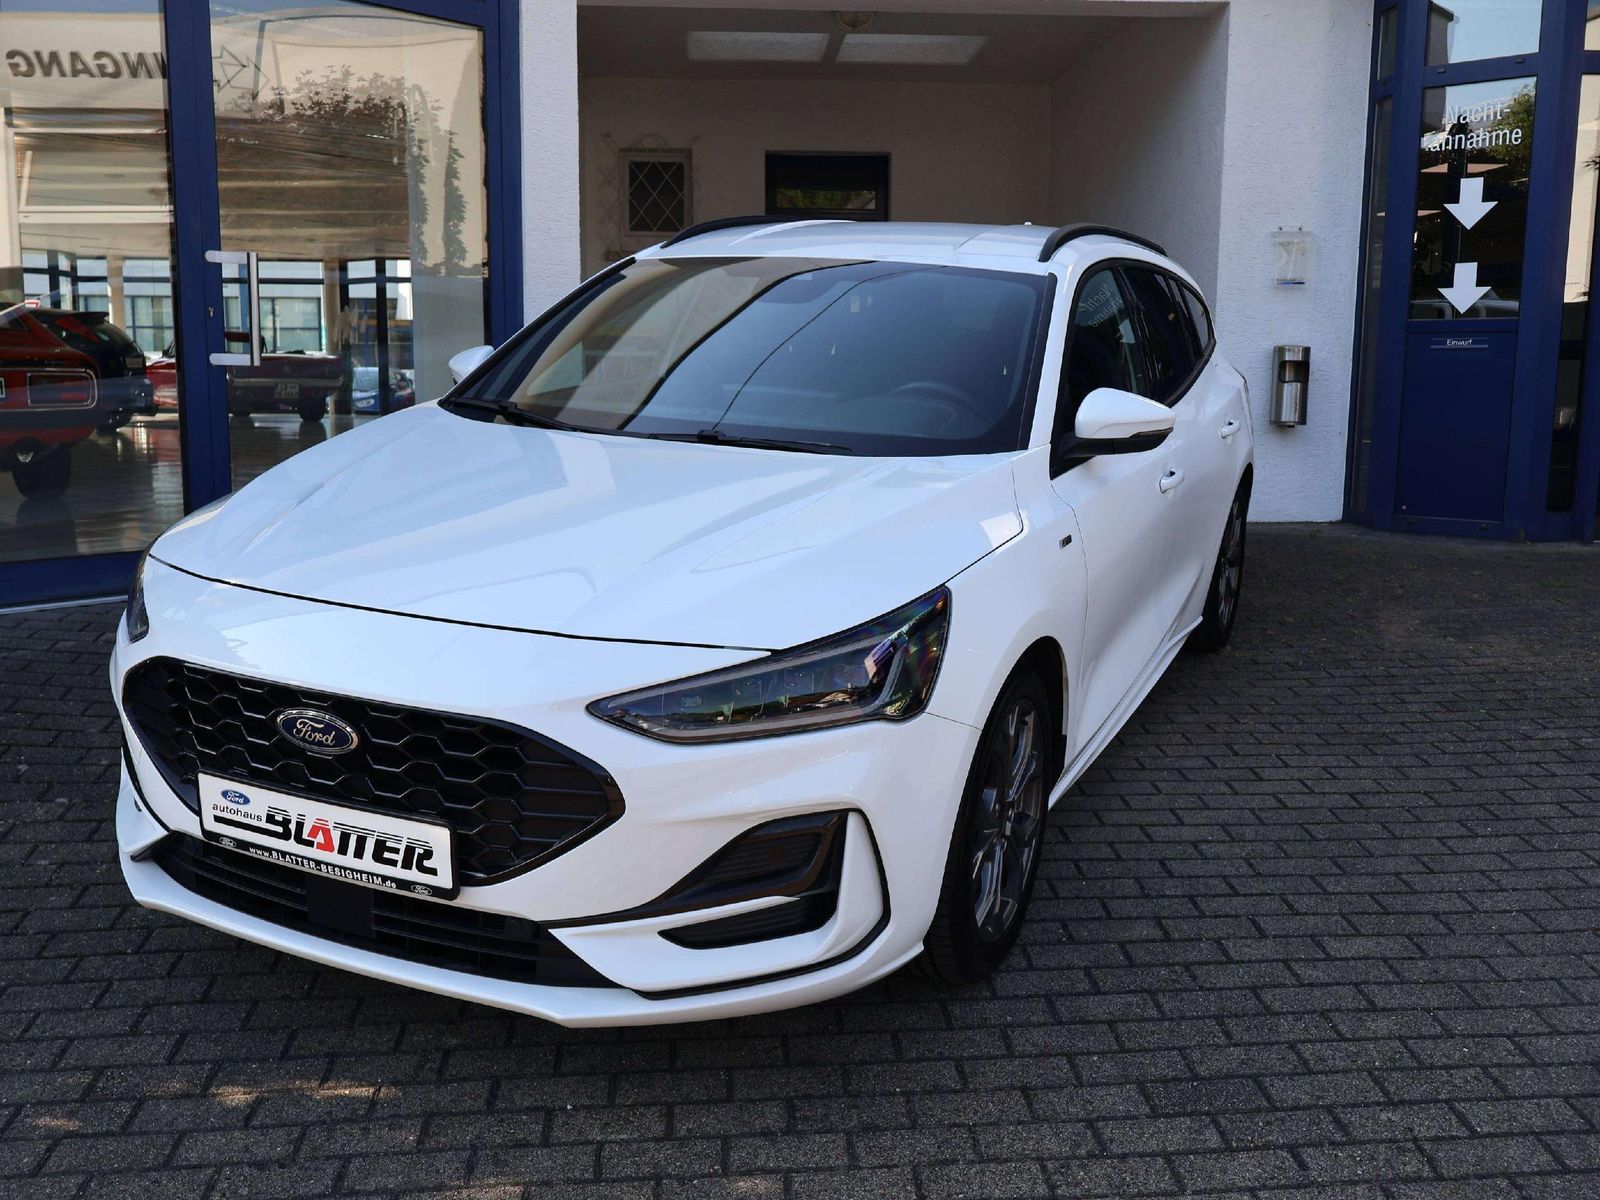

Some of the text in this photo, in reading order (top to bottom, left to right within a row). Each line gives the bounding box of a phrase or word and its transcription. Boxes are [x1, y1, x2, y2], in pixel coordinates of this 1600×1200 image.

[1446, 102, 1511, 124] Nacht-
[1429, 127, 1523, 152] annahme
[292, 718, 336, 746] Ford
[225, 789, 246, 805] Ford
[212, 803, 263, 823] autohaus
[265, 806, 438, 877] BLATTER
[249, 846, 397, 889] www.BLATTER-BESIGHEIM.de
